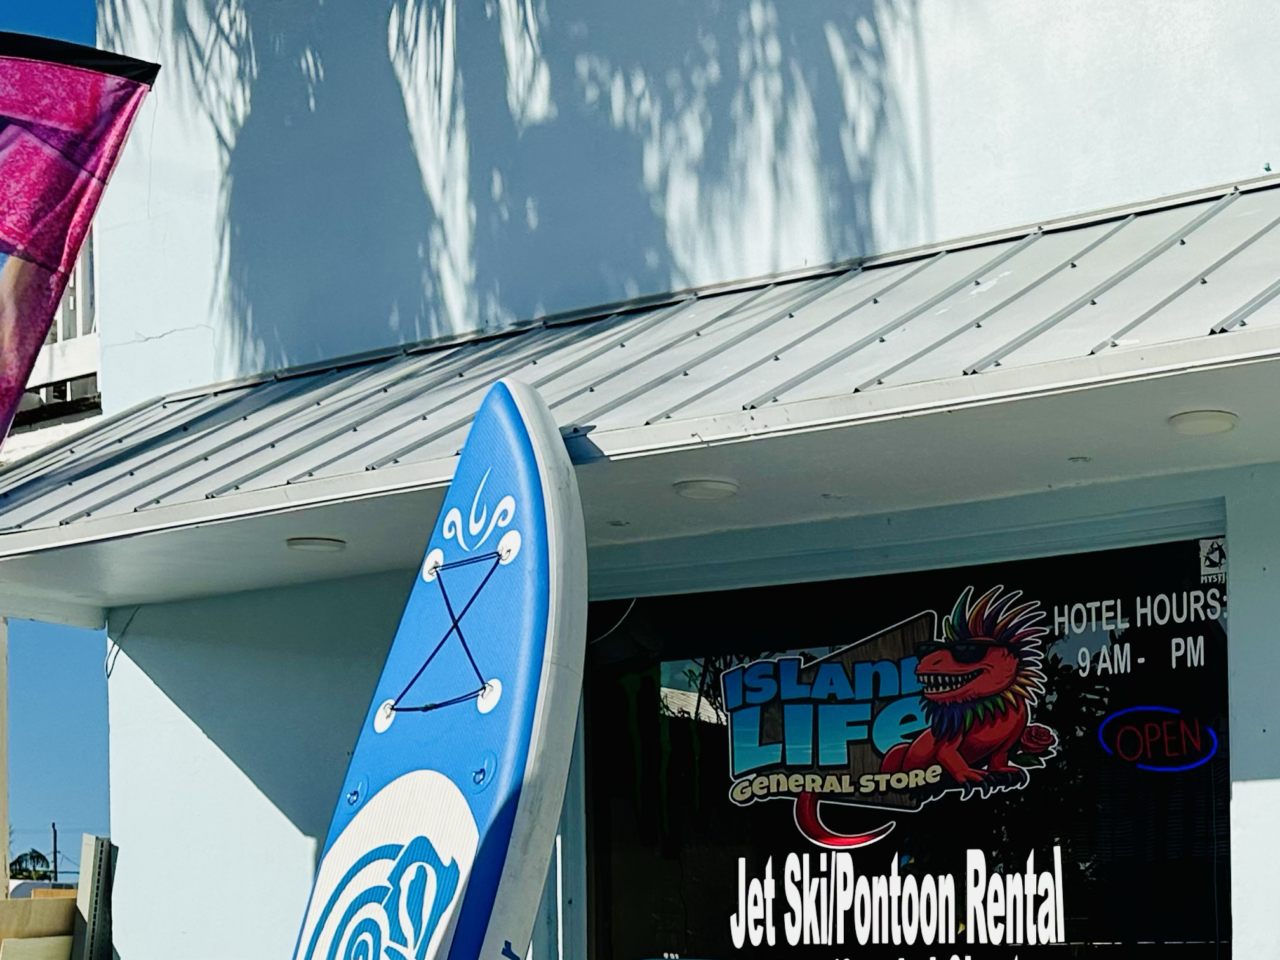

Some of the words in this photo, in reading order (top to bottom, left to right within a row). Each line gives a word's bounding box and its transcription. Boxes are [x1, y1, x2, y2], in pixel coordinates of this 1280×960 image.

[1054, 599, 1130, 636] HOTEL
[1078, 647, 1091, 677] 9
[1097, 643, 1131, 676] AM
[1171, 635, 1205, 669] PM
[1115, 718, 1201, 761] OPEN
[730, 856, 776, 949] Jet
[966, 845, 1066, 945] Rental
